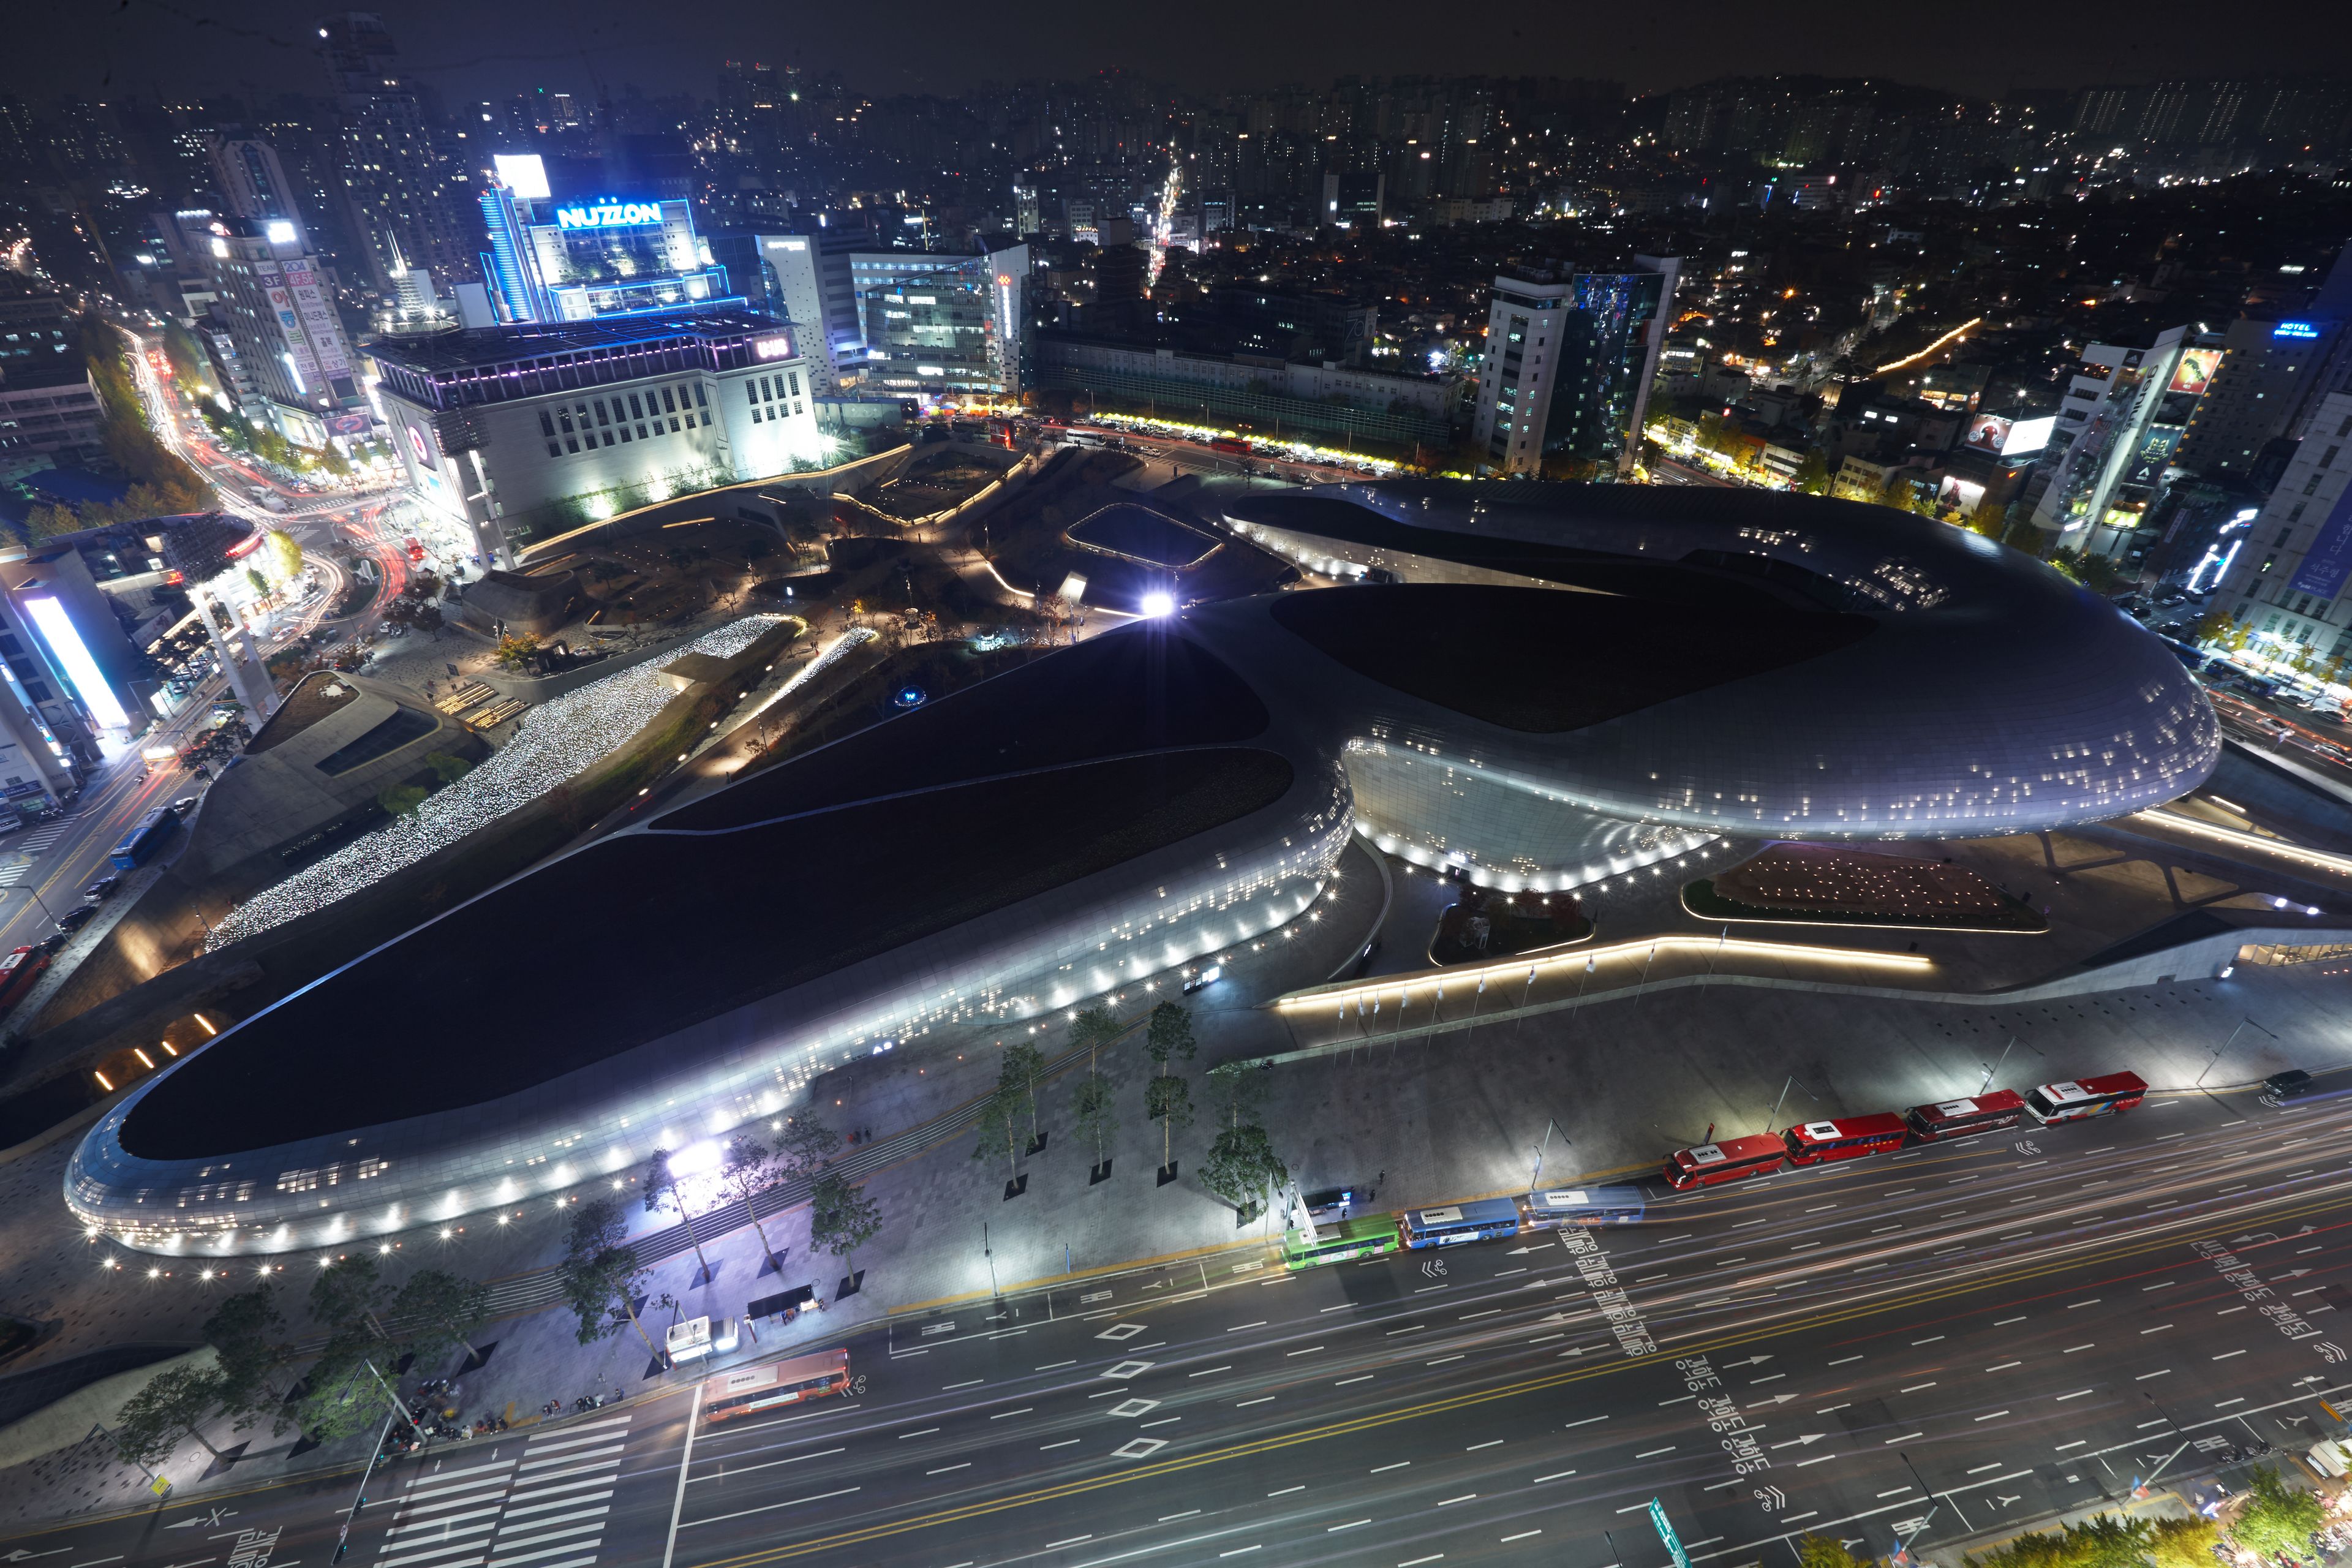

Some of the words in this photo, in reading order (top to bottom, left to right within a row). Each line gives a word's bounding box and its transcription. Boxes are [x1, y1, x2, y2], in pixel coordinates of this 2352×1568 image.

[557, 201, 663, 228] NUZZON
[284, 261, 306, 272] 204
[264, 276, 281, 286] 3F
[298, 289, 317, 301] 원피스
[271, 290, 307, 346] 아동복
[303, 311, 329, 322] 미니드레스
[2280, 322, 2312, 331] HOTEL
[300, 362, 317, 372] 전문
[2122, 364, 2159, 434] genius
[2190, 1239, 2242, 1273] 신당역
[2224, 1268, 2275, 1302] 광희동
[2259, 1301, 2313, 1335] 광희동
[1675, 1355, 1721, 1392] 광희동
[1698, 1393, 1746, 1433] 광희동
[1721, 1433, 1771, 1475] 광희동
